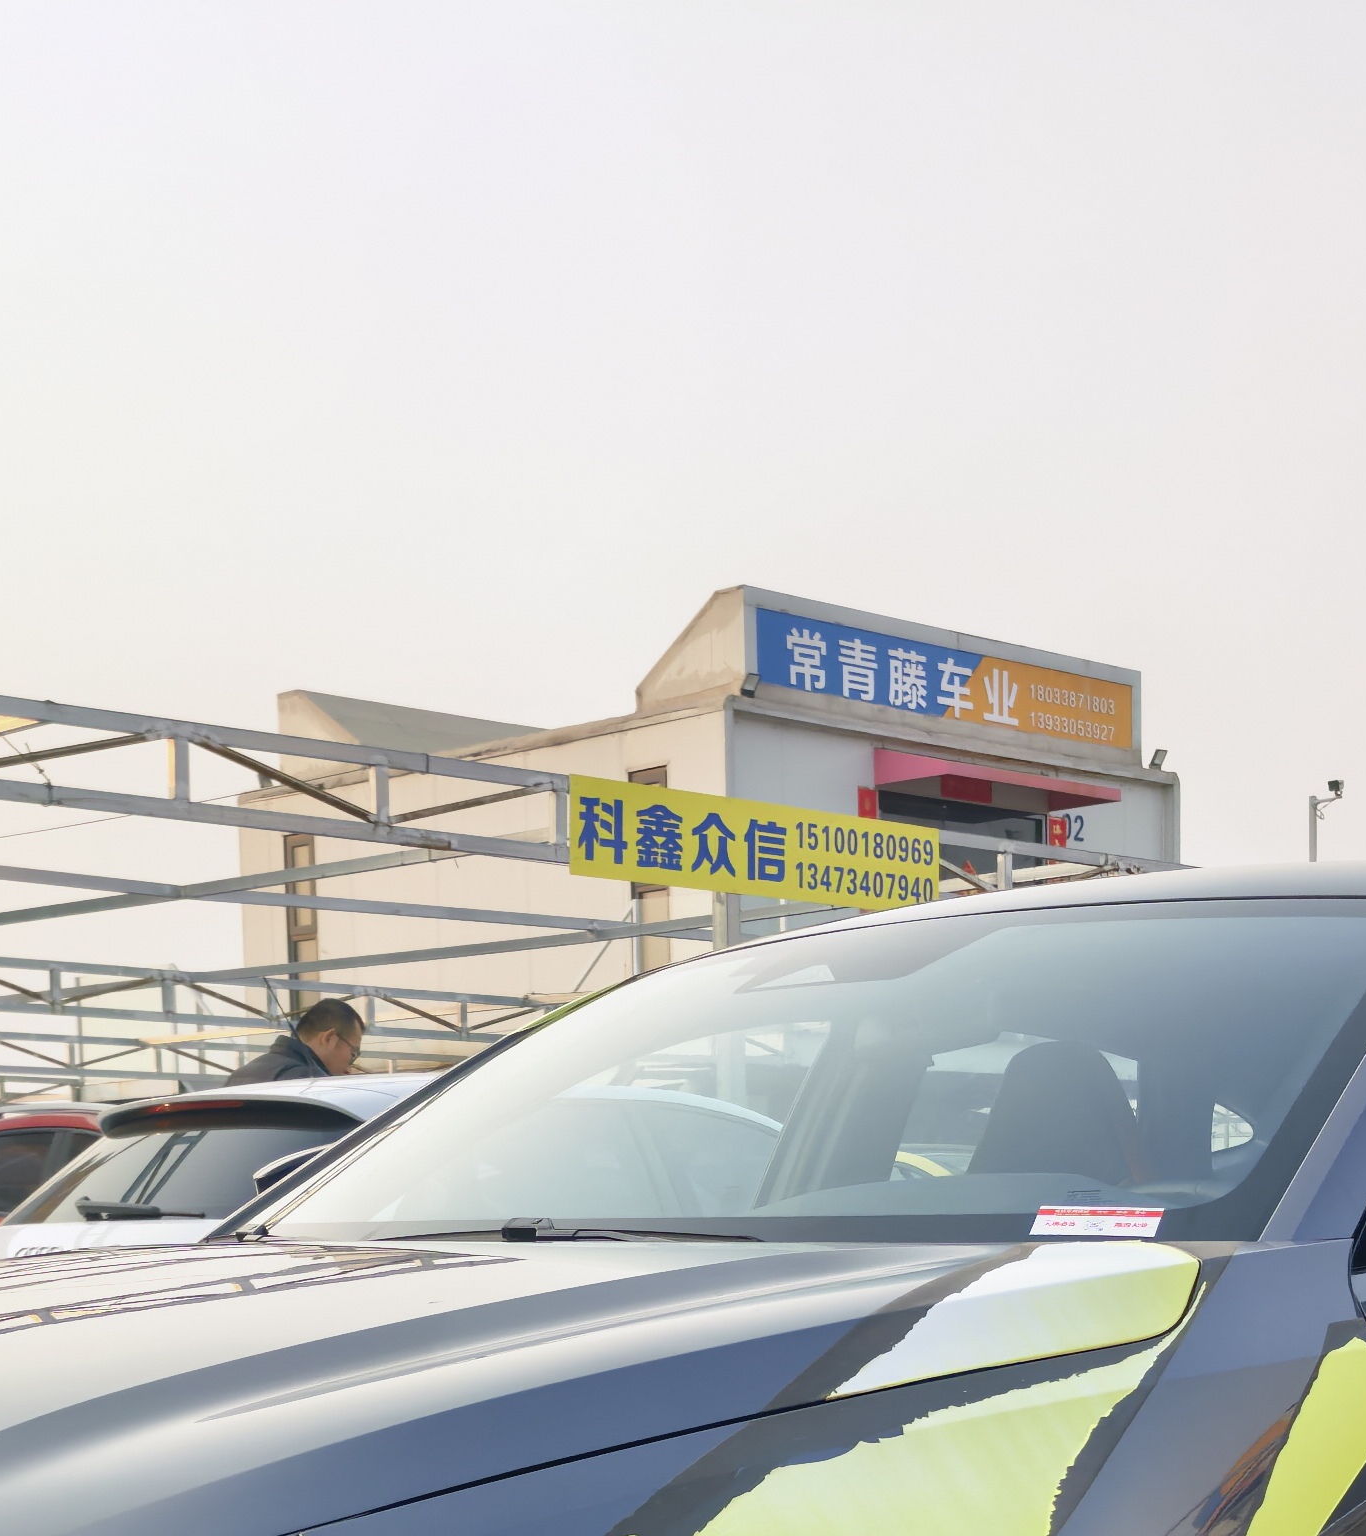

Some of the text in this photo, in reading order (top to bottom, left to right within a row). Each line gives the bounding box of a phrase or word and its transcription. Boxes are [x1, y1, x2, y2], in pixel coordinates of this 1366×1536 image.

[786, 628, 1019, 726] 常青藤车业
[1030, 683, 1115, 715] 18033871803
[1030, 711, 1115, 741] 13933053927
[578, 797, 787, 882] 科鑫众信
[795, 821, 934, 866] 15100180969
[795, 861, 934, 903] 13473407940
